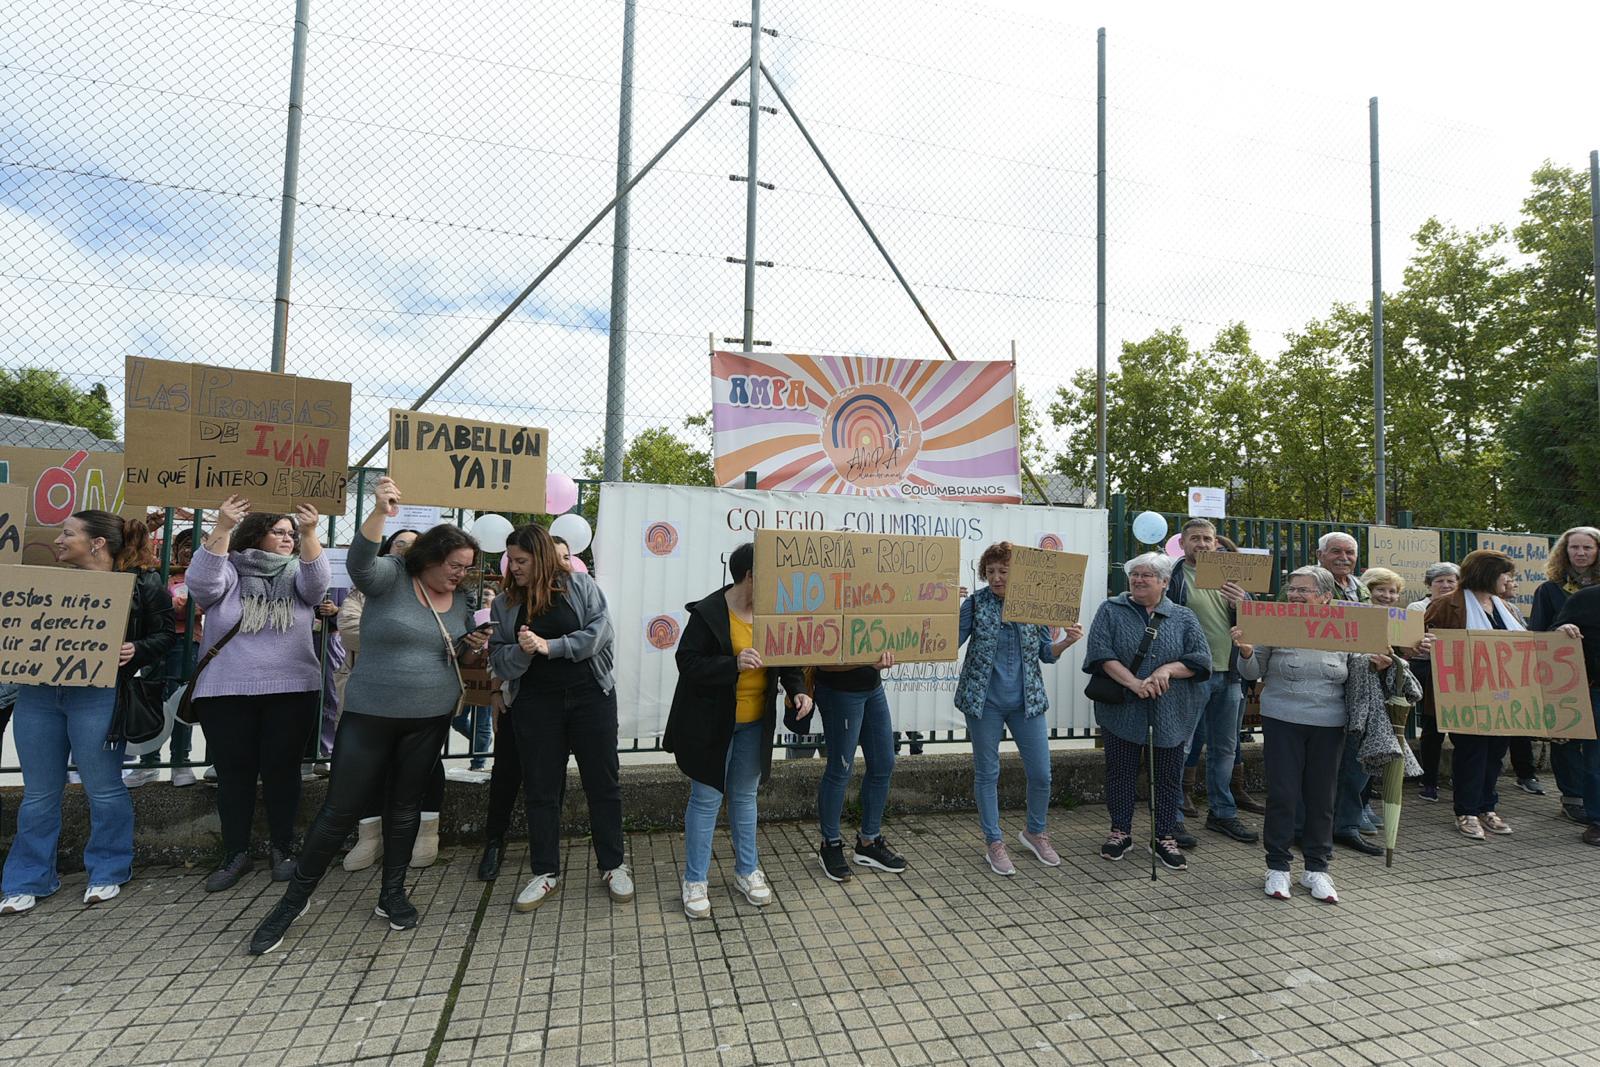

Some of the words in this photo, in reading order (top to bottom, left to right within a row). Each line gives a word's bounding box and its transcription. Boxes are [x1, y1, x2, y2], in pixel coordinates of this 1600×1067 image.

[129, 361, 190, 412] LAS
[198, 367, 339, 428] PROMESAS
[729, 375, 809, 410] AMPA
[200, 420, 240, 444] DE
[246, 423, 329, 469] IVÁN
[127, 467, 149, 485] EN
[157, 464, 188, 488] QUÉ
[272, 467, 347, 504] ESTÁN?
[450, 453, 512, 490] YA!!
[901, 483, 1006, 497] COLUMBRIANOS
[775, 534, 856, 569] MARÍA
[877, 537, 945, 575] ROCÍO
[1374, 532, 1393, 550] LOS
[61, 593, 112, 611] niños
[775, 572, 826, 615] NO
[829, 572, 896, 611] TENGAS
[903, 585, 913, 602] A
[917, 581, 950, 602] LOS
[30, 612, 107, 631] derecho
[1304, 618, 1360, 642] YA!!
[29, 635, 51, 652] al
[55, 638, 109, 652] recreo
[51, 655, 103, 683] YA!
[1434, 639, 1581, 695] HARTOS
[1440, 695, 1583, 733] MOJARNOS
